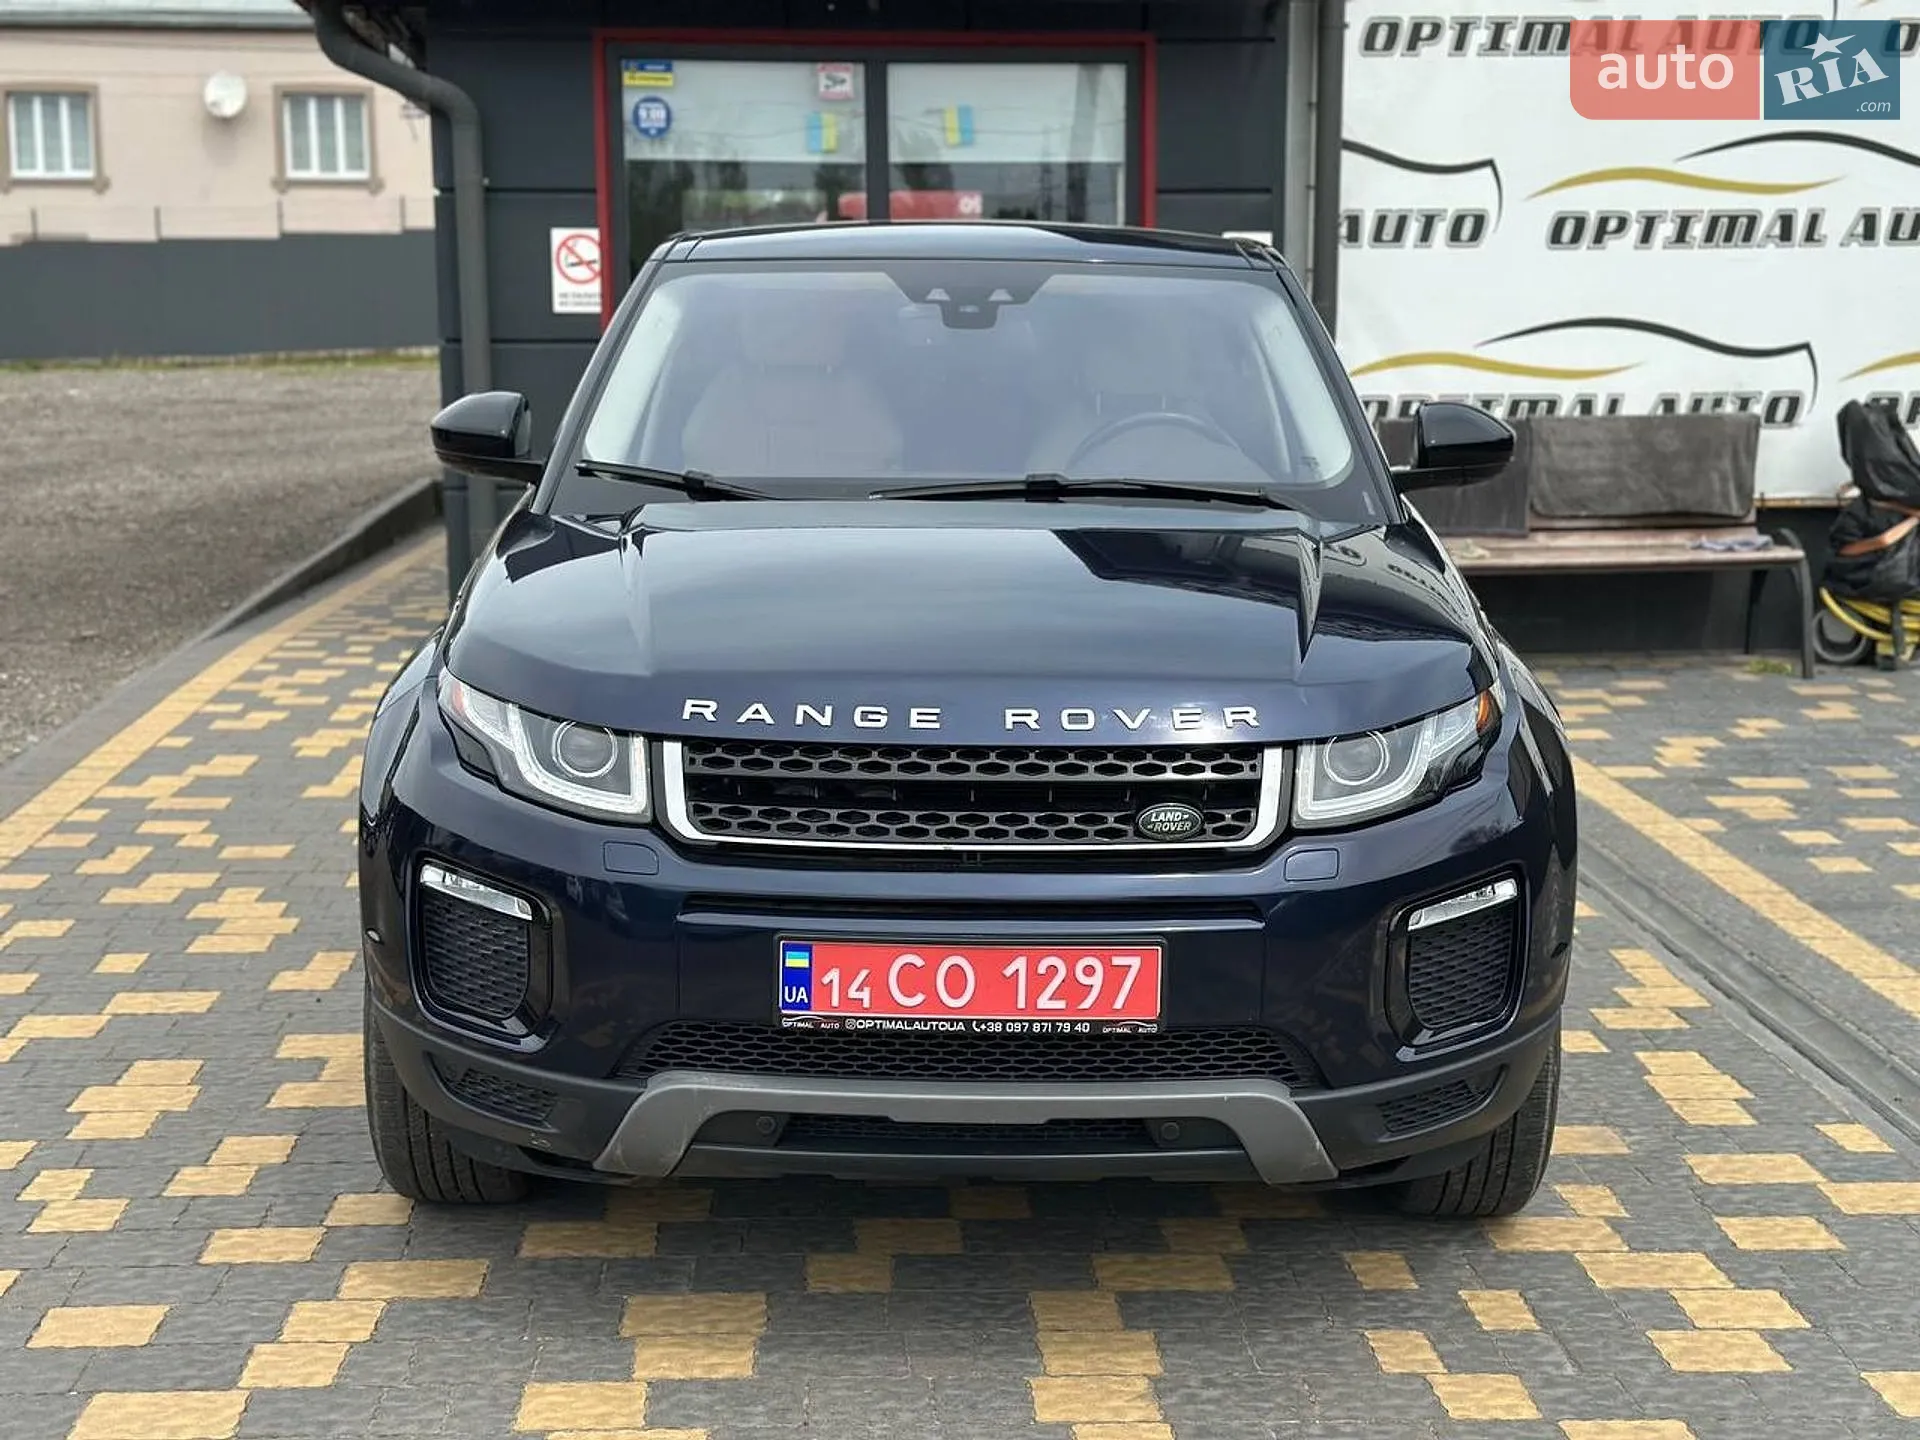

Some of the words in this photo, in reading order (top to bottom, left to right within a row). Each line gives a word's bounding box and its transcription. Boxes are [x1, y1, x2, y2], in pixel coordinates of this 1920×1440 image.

[1358, 16, 1642, 57] OPTIMAL
[1657, 15, 1826, 57] AUTO
[1545, 208, 1828, 250] OPTIMAL
[682, 698, 941, 729] RANGE
[1004, 706, 1260, 731] ROVER
[1151, 812, 1181, 822] LAND
[1153, 821, 1192, 832] ROVER
[820, 967, 872, 1009] 14
[887, 952, 976, 1009] CO
[1001, 954, 1143, 1010] 1297
[784, 986, 808, 1004] UA
[1006, 1022, 1029, 1032] 097
[1055, 1022, 1071, 1033] 79
[1073, 1022, 1090, 1033] 40
